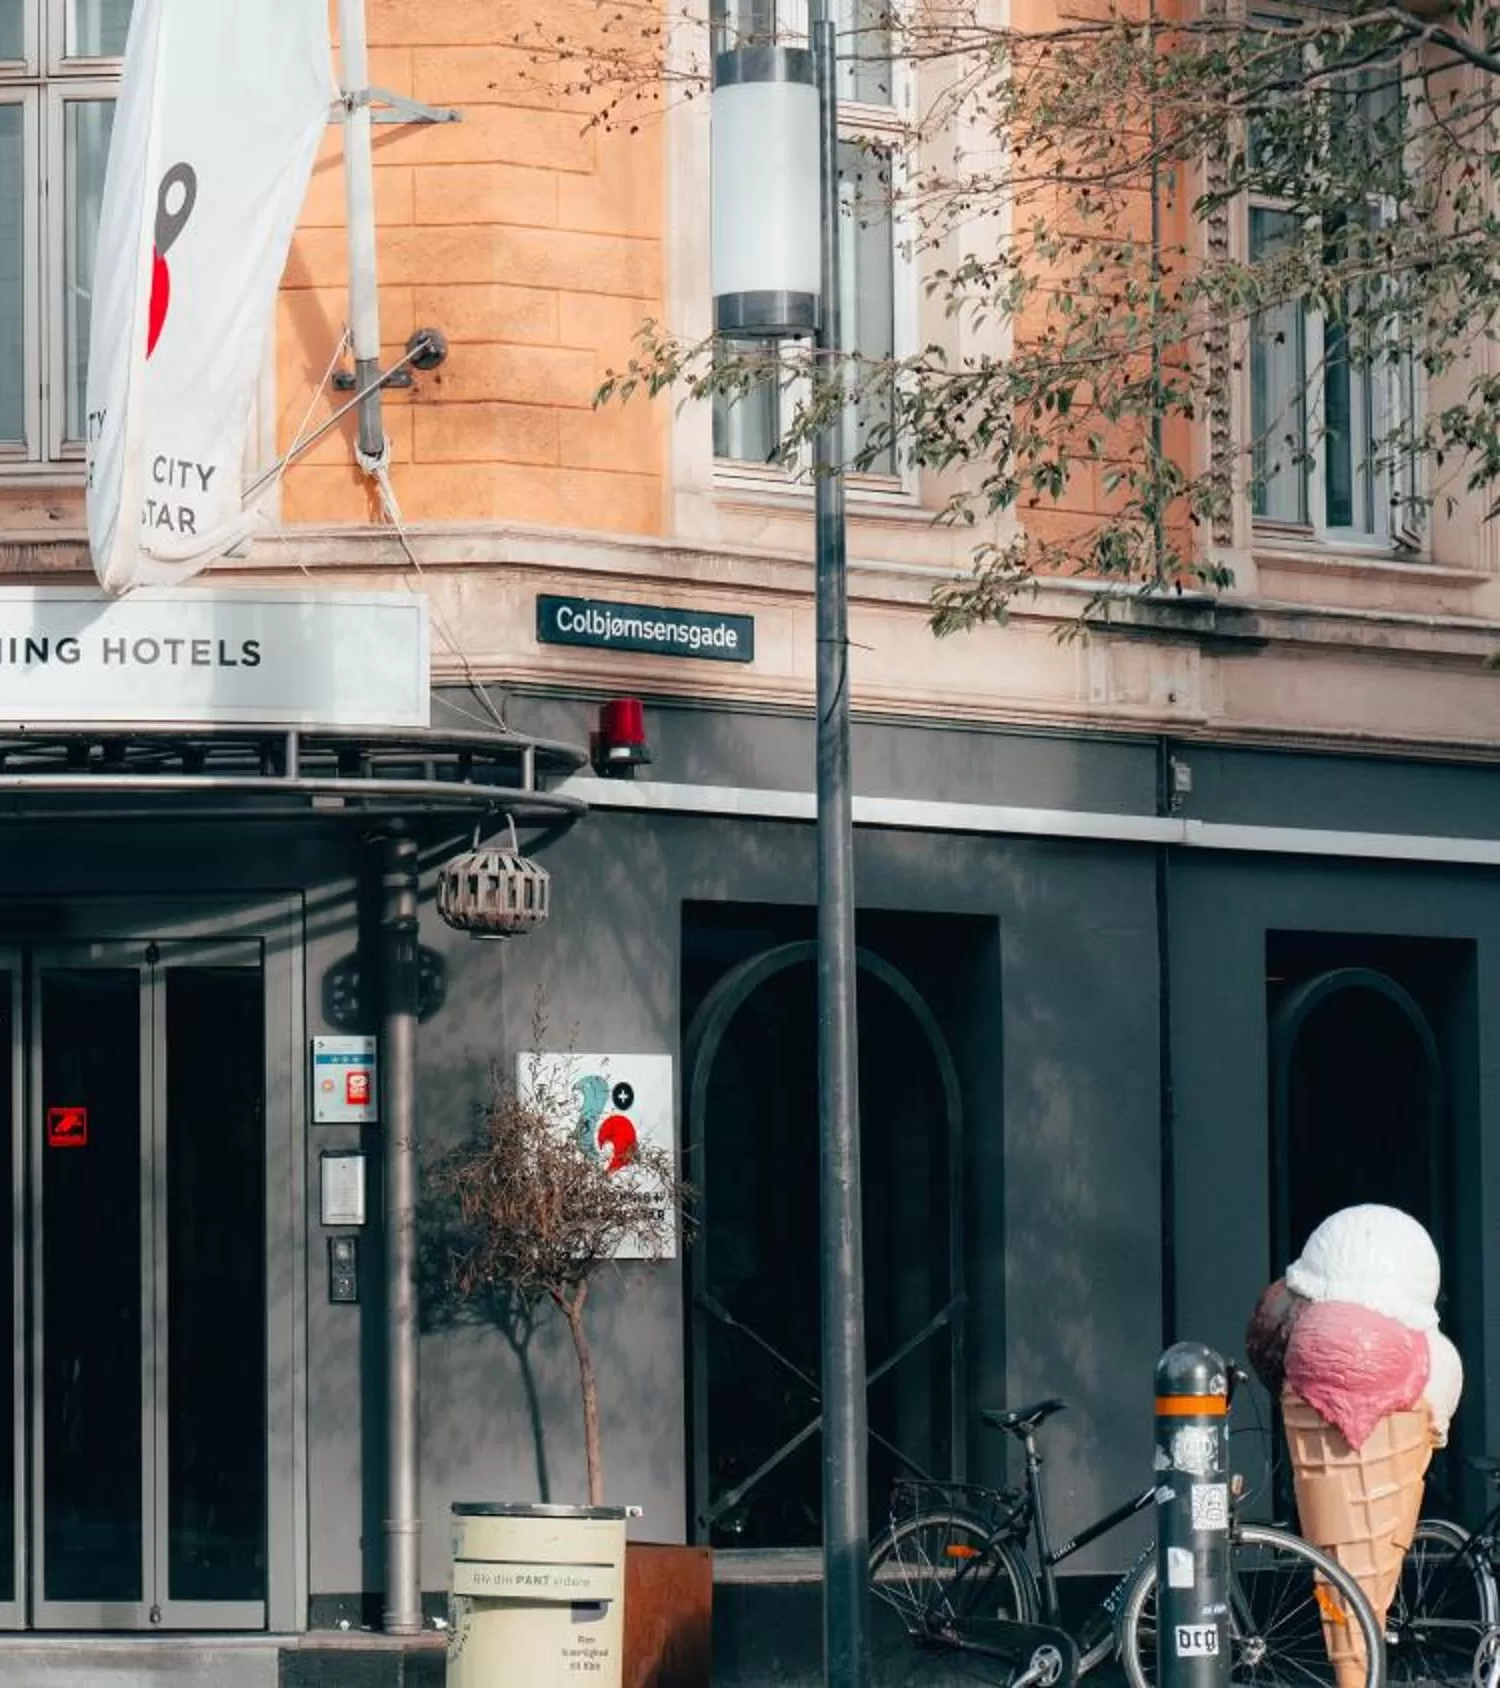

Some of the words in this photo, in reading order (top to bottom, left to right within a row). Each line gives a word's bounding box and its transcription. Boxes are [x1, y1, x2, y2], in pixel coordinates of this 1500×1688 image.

[152, 455, 216, 492] CITY
[102, 637, 261, 667] HOTELS
[515, 1575, 549, 1586] PANT
